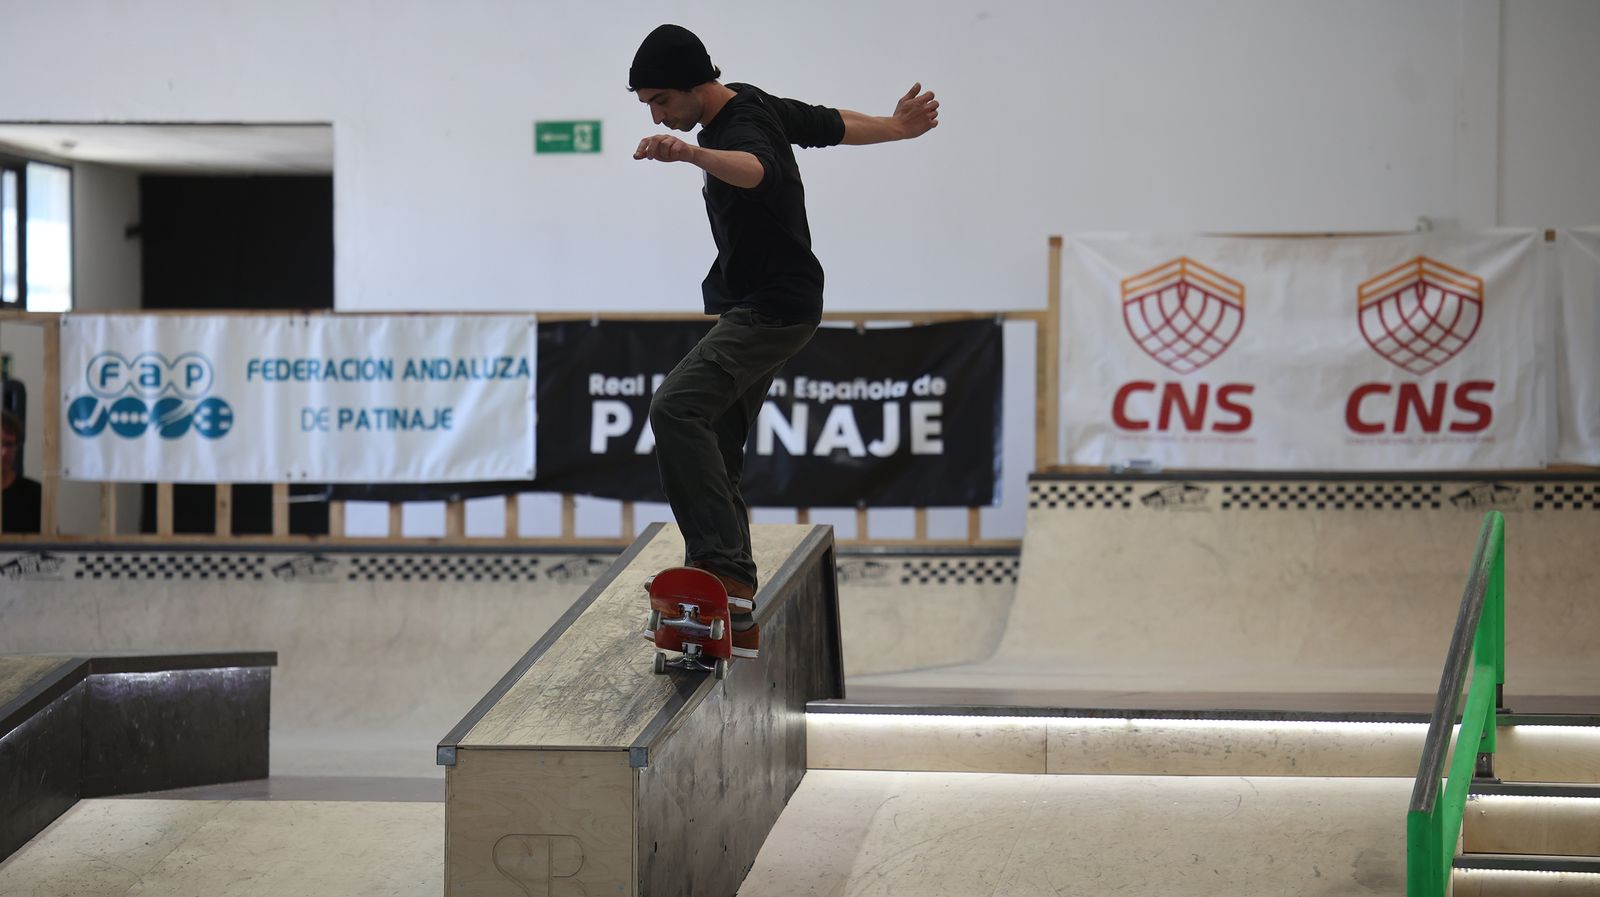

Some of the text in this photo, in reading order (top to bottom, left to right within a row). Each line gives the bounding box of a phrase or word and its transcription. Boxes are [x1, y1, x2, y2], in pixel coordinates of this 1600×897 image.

[403, 356, 530, 380] ANDALUZA
[589, 373, 645, 395] Real
[793, 376, 908, 403] Española
[912, 374, 947, 396] de
[301, 407, 454, 432] DE PATINAJE
[590, 400, 944, 456] PNAJE
[1112, 380, 1255, 434] CNS
[1345, 380, 1495, 434] CNS
